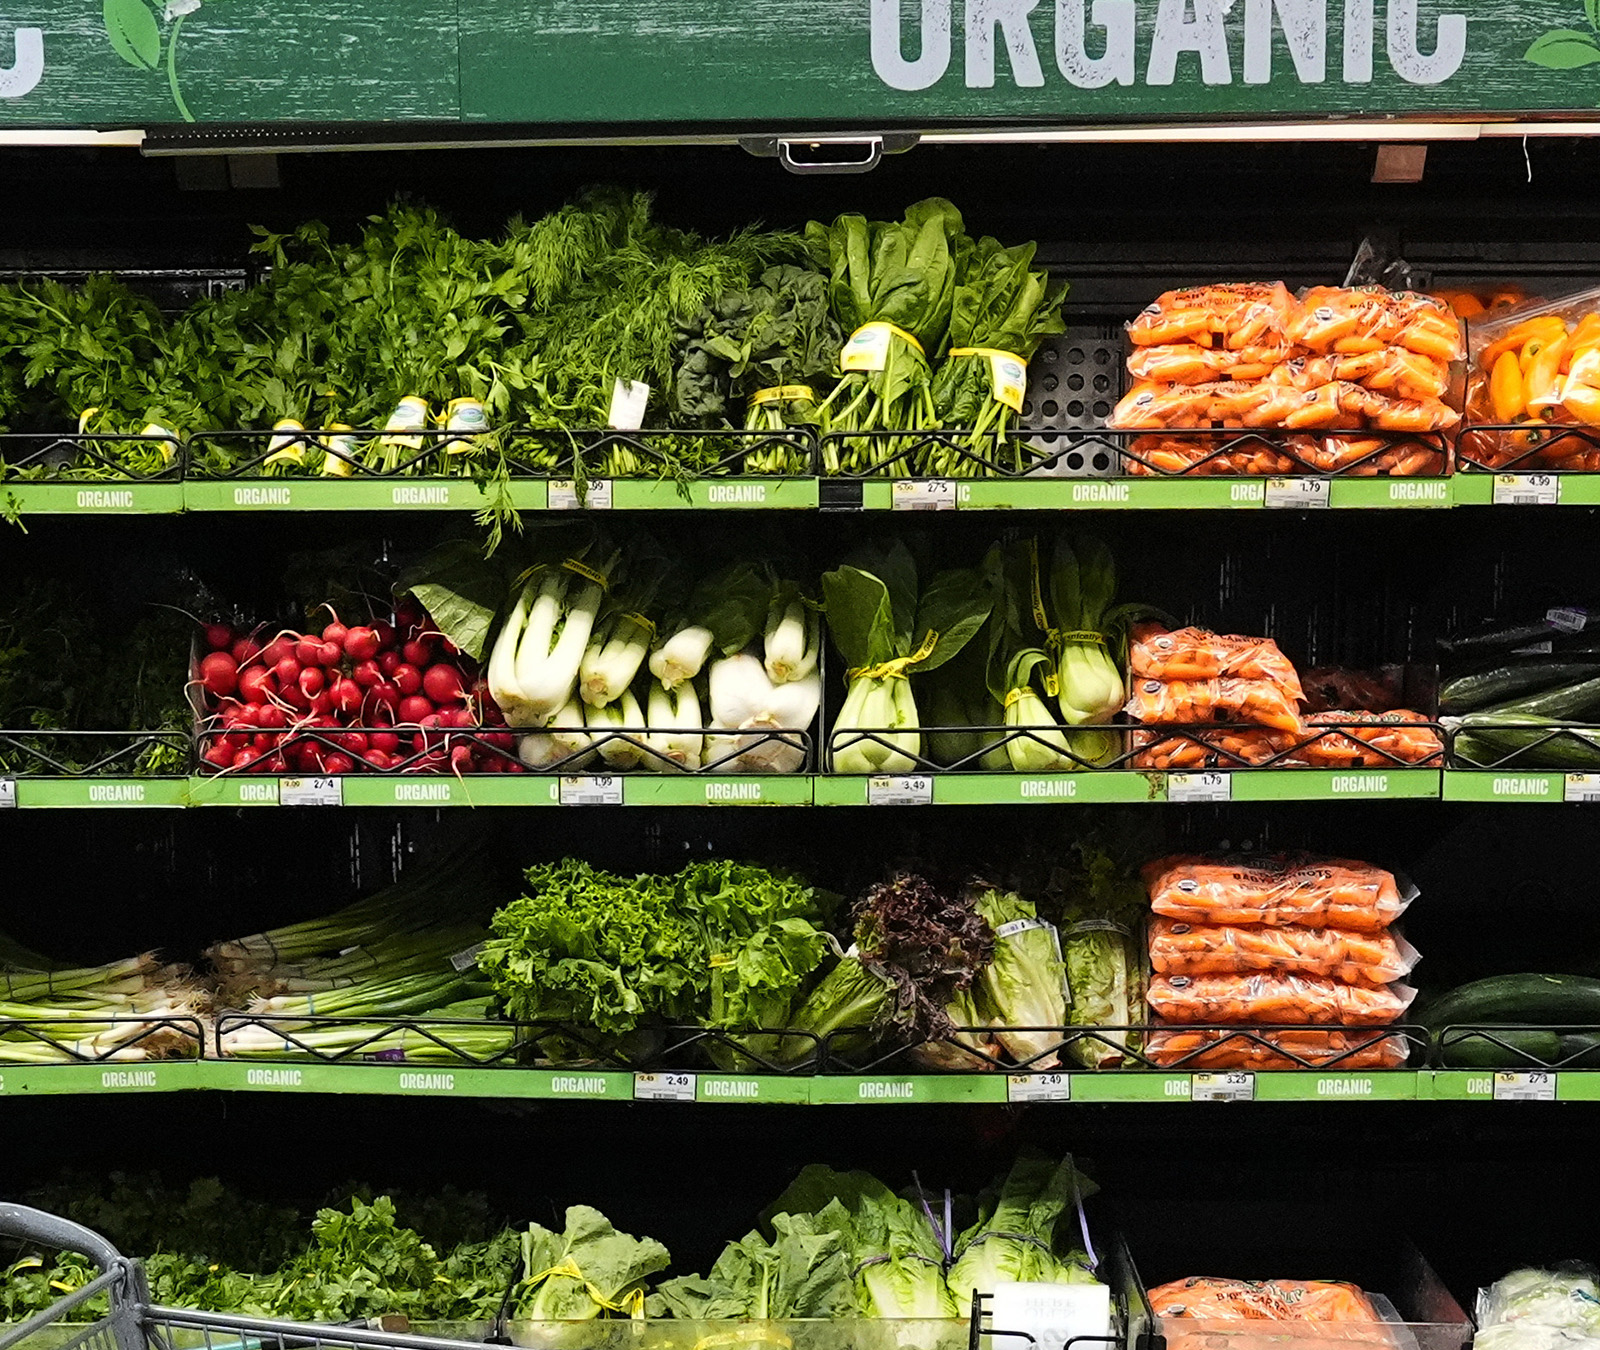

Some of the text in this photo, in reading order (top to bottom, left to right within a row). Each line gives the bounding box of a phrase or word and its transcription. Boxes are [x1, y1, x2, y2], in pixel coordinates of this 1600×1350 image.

[77, 491, 133, 507] ORGANIC
[234, 488, 290, 505] ORGANIC
[393, 487, 448, 504] ORGANIC
[709, 486, 765, 502] ORGANIC
[1072, 484, 1129, 501] ORGANIC
[1230, 484, 1265, 501] ORGA
[1390, 483, 1446, 499] ORGANIC
[395, 784, 450, 800] ORGANIC
[705, 783, 761, 799] ORGANIC
[1021, 781, 1076, 797] ORGANIC
[1332, 776, 1387, 792] ORGANIC
[1493, 778, 1549, 794] ORGANIC
[89, 785, 144, 801] ORGANIC
[102, 1071, 156, 1087] ORGANIC
[247, 1069, 302, 1085] ORGANIC
[399, 1073, 454, 1089] ORGANIC
[551, 1077, 606, 1093] ORGANIC
[704, 1081, 759, 1097] ORGANIC
[859, 1082, 913, 1098] ORGANIC
[1317, 1079, 1372, 1095] ORGANIC
